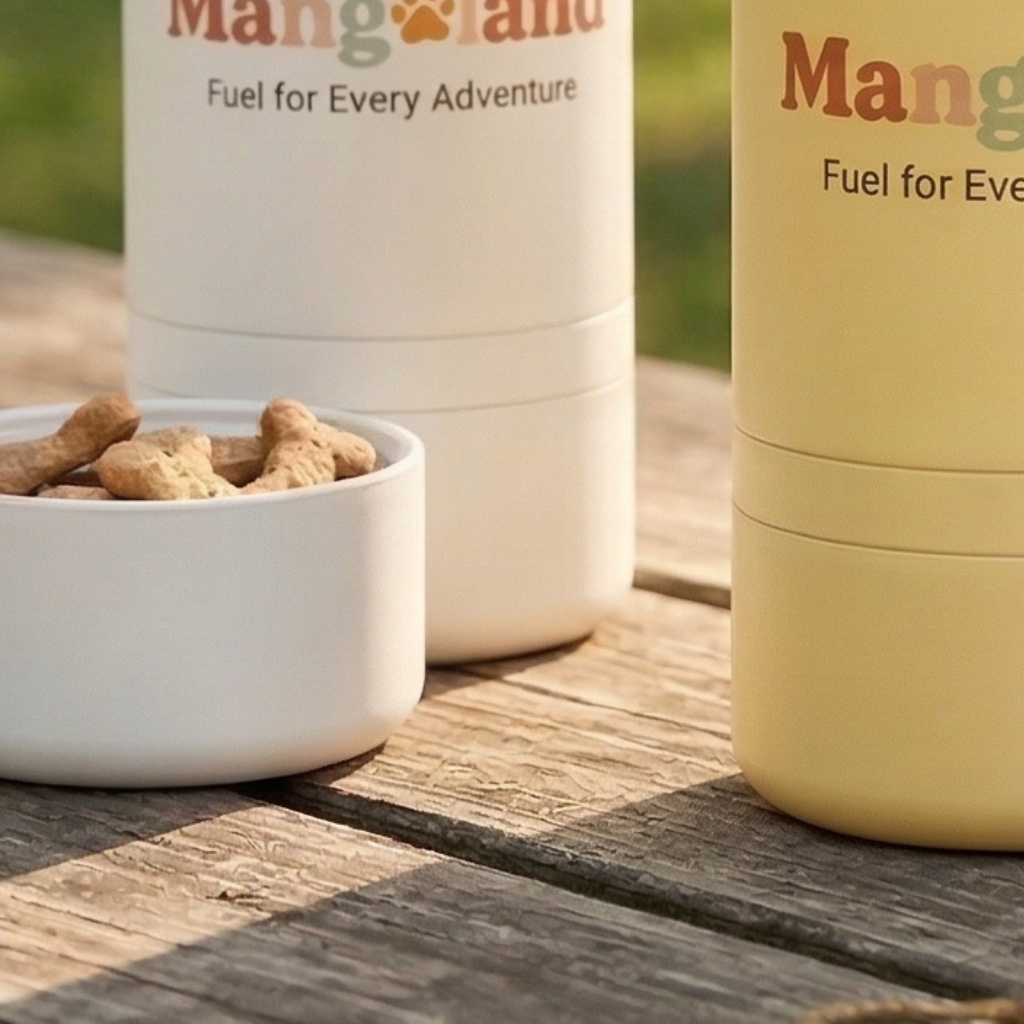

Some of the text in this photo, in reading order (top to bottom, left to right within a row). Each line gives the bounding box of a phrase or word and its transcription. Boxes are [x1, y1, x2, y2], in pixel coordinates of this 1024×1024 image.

[207, 77, 578, 120] Fuel for Every Adventure
[822, 158, 889, 197] Fuel
[901, 163, 953, 200] for
